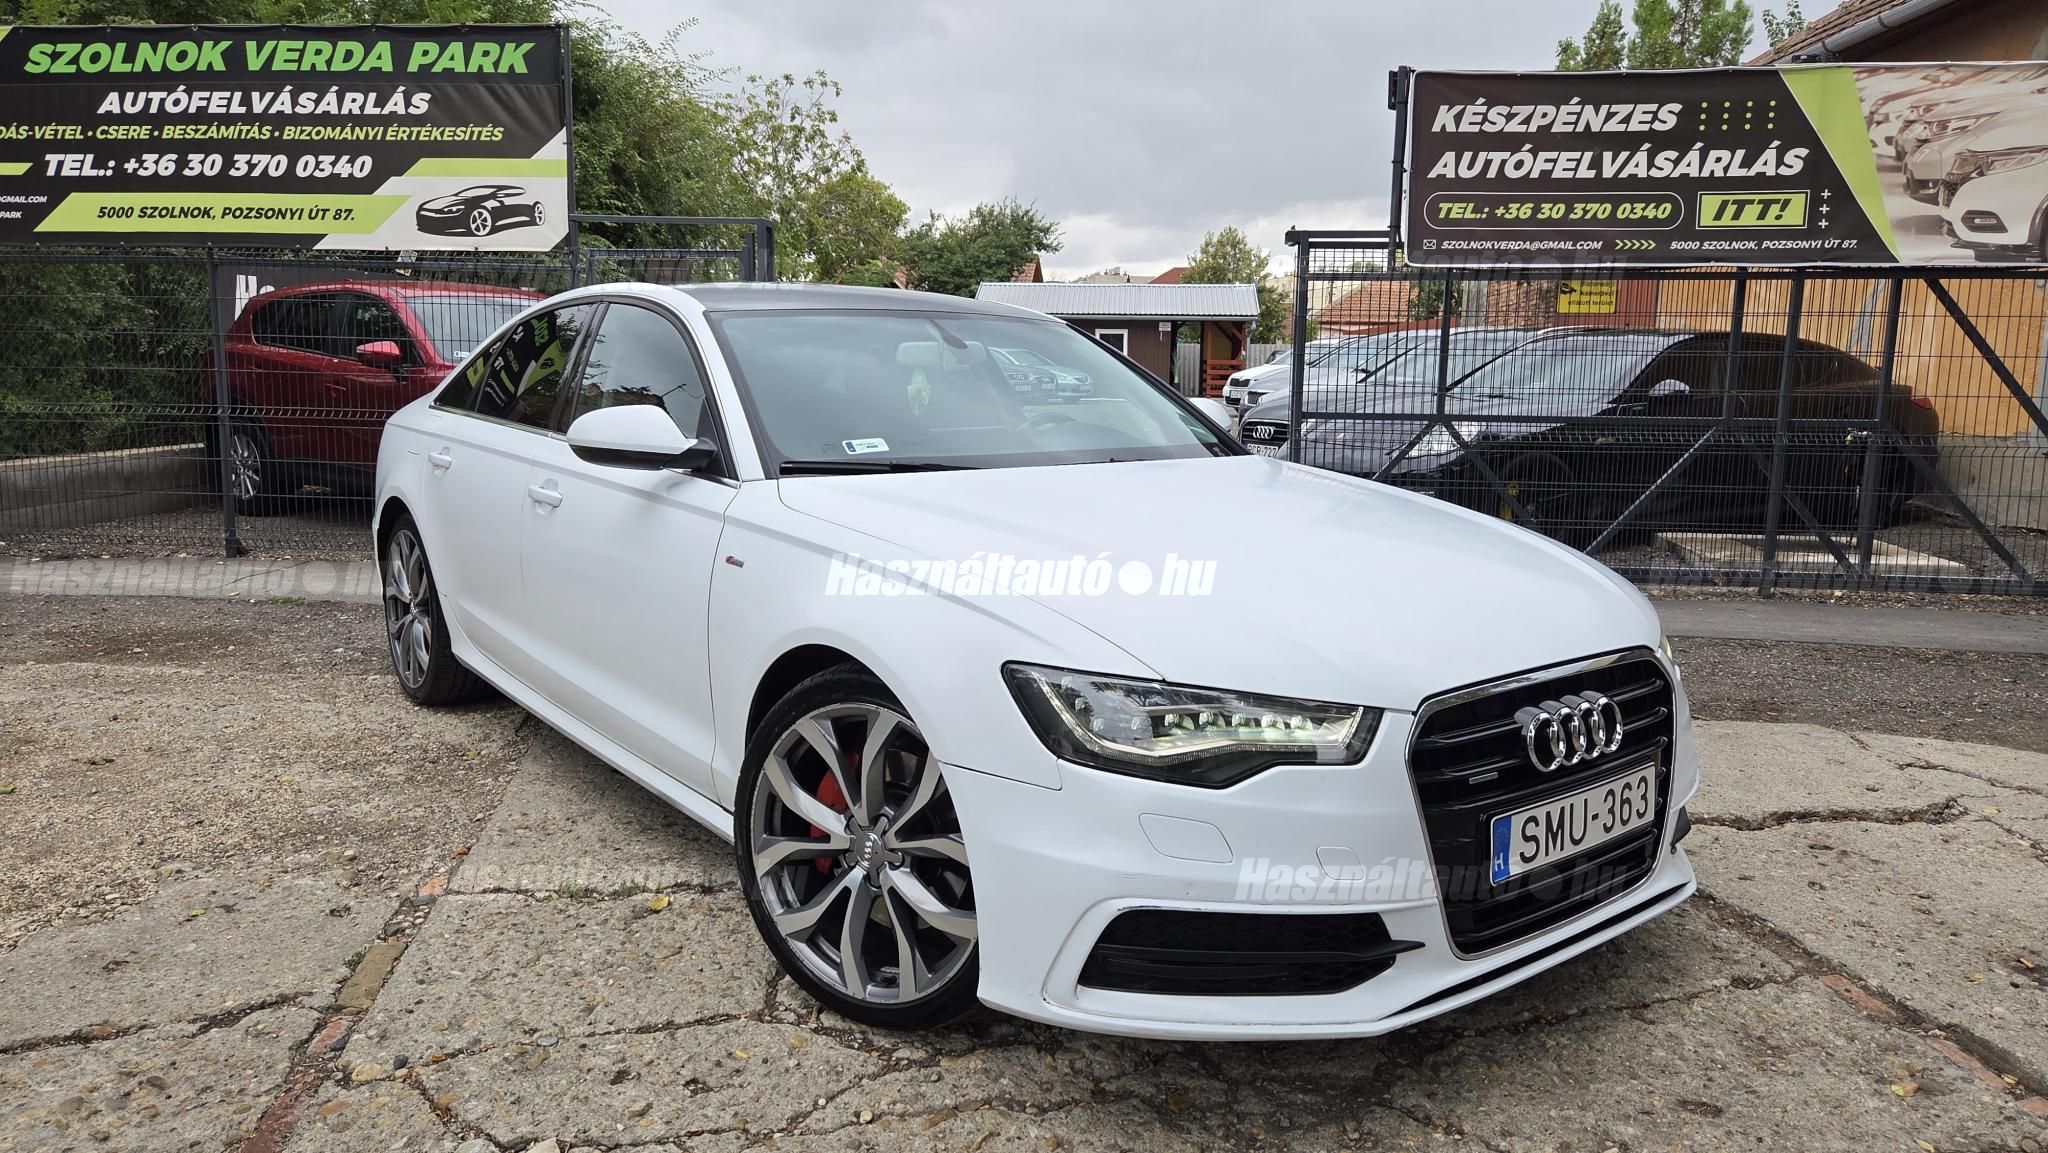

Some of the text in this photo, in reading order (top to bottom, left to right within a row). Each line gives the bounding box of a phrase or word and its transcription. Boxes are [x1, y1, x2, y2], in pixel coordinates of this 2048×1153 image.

[23, 40, 536, 74] SZOLNOK VERDA PARK
[96, 84, 432, 115] AUTÓFELVÁSÁRLÁS
[1431, 96, 1684, 133] KÉSZPÉNZES
[95, 125, 153, 140] CSERE
[161, 122, 273, 140] BESZÁMÍTÁS
[282, 123, 384, 141] BIZOMÁNYI
[385, 124, 505, 141] ÉRTÉKESÍTÉS
[44, 153, 373, 179] TEL.: +36 30 370 0340
[1426, 139, 1810, 179] AUTÓFELVÁSÁRLÁS
[96, 204, 355, 221] 5000 SZOLNOK, POZSONYI ÚT 87.
[1438, 202, 1672, 220] TEL.: +36 30 370 0340
[1711, 198, 1793, 222] ITT!
[1440, 237, 1858, 251] SZOLNOKVERDA@GMAIL.COM 5000 SZOLNOK, POZSONYI ÚT 87.
[1518, 774, 1649, 865] SMU-363
